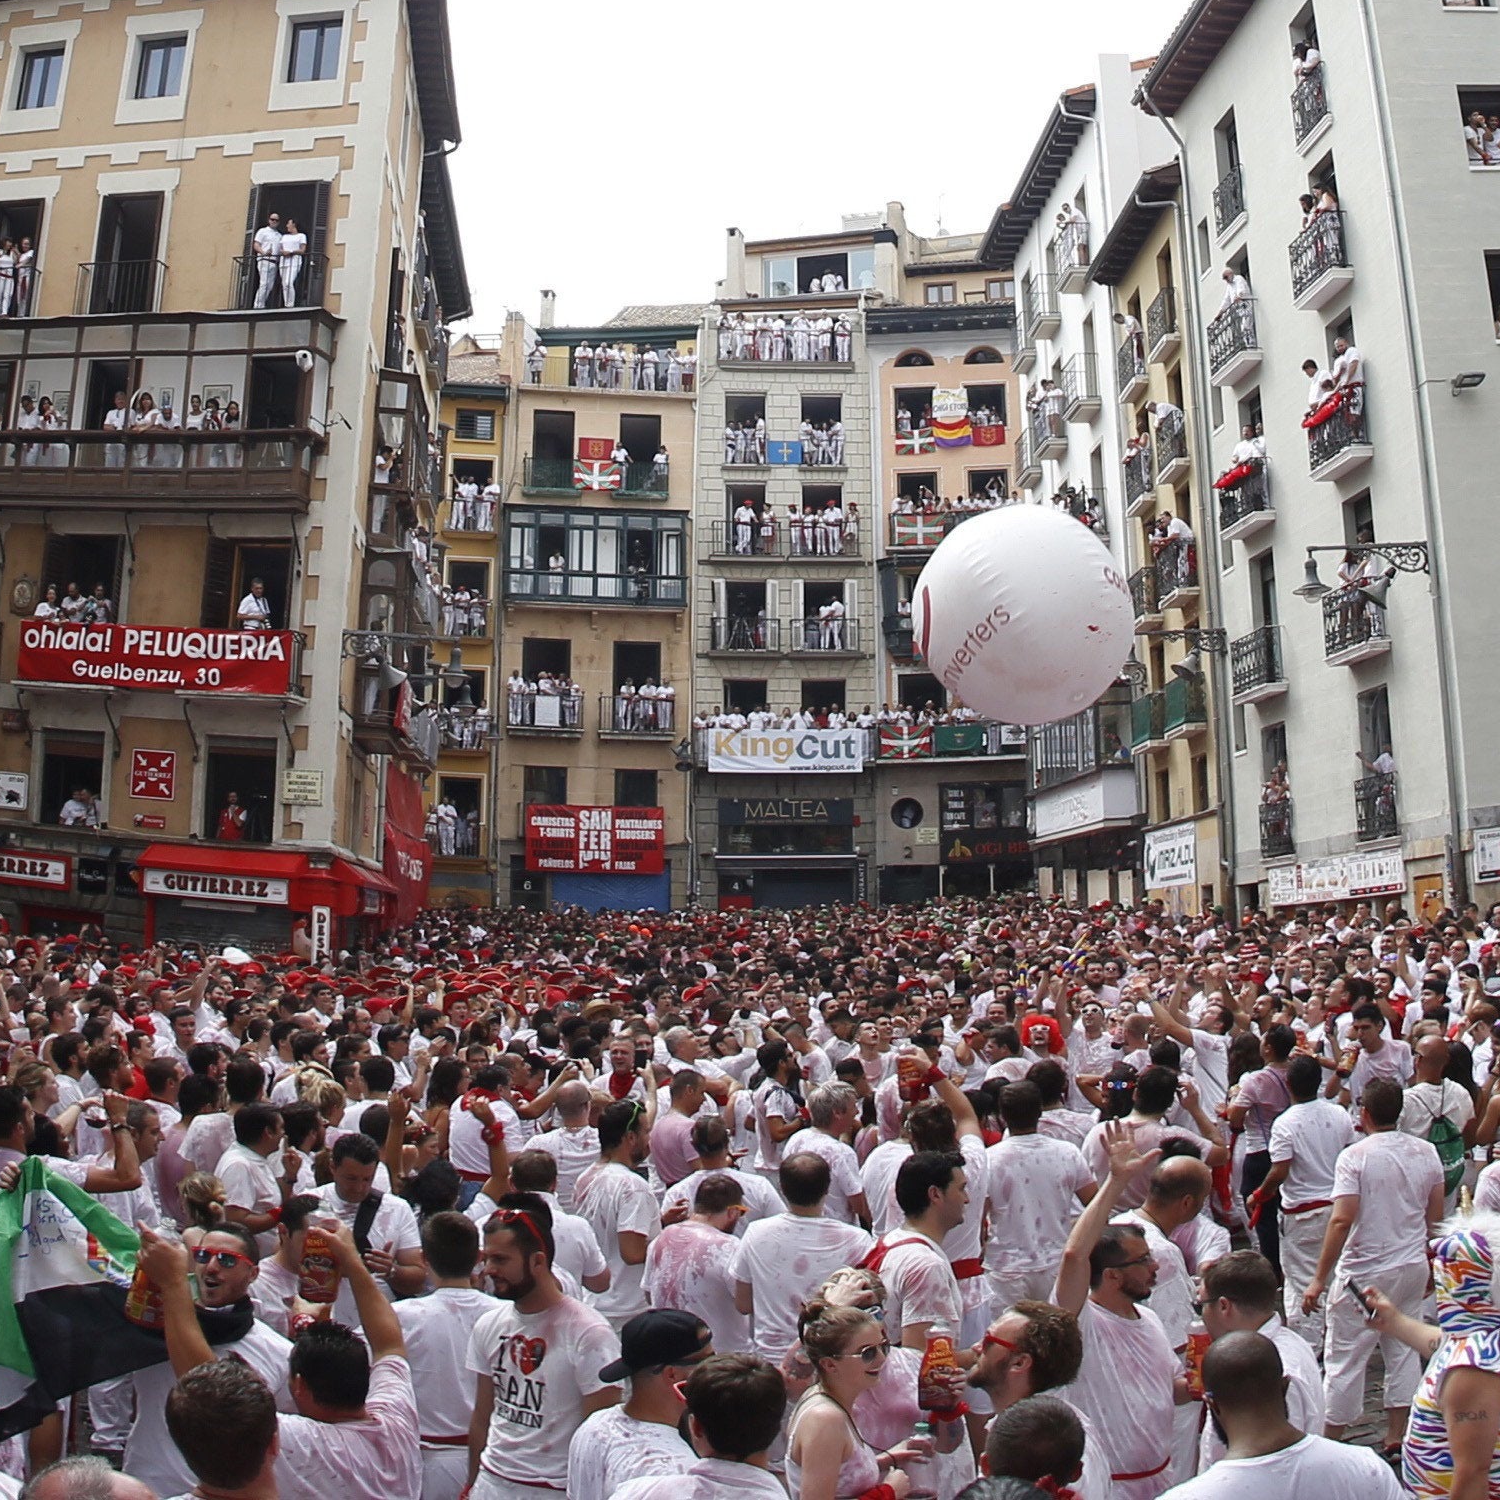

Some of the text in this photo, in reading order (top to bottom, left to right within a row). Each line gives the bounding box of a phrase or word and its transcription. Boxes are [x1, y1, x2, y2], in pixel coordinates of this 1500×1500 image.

[24, 625, 285, 661] ohlala! PELUQUERIA
[72, 660, 220, 686] Guelbenzu, 30
[744, 800, 829, 818] MALTEA
[531, 816, 575, 827] CAMISETAS
[579, 810, 612, 830] SAN
[615, 819, 662, 829] PANTALONES
[540, 827, 575, 838] T-SHIRTS
[615, 830, 656, 840] TROUSERS
[579, 830, 611, 850] FER
[903, 846, 913, 859] 2
[539, 858, 574, 869] PAÑUELOS
[163, 873, 269, 898] GUTIERREZ
[523, 881, 532, 891] 6
[732, 882, 740, 891] 4
